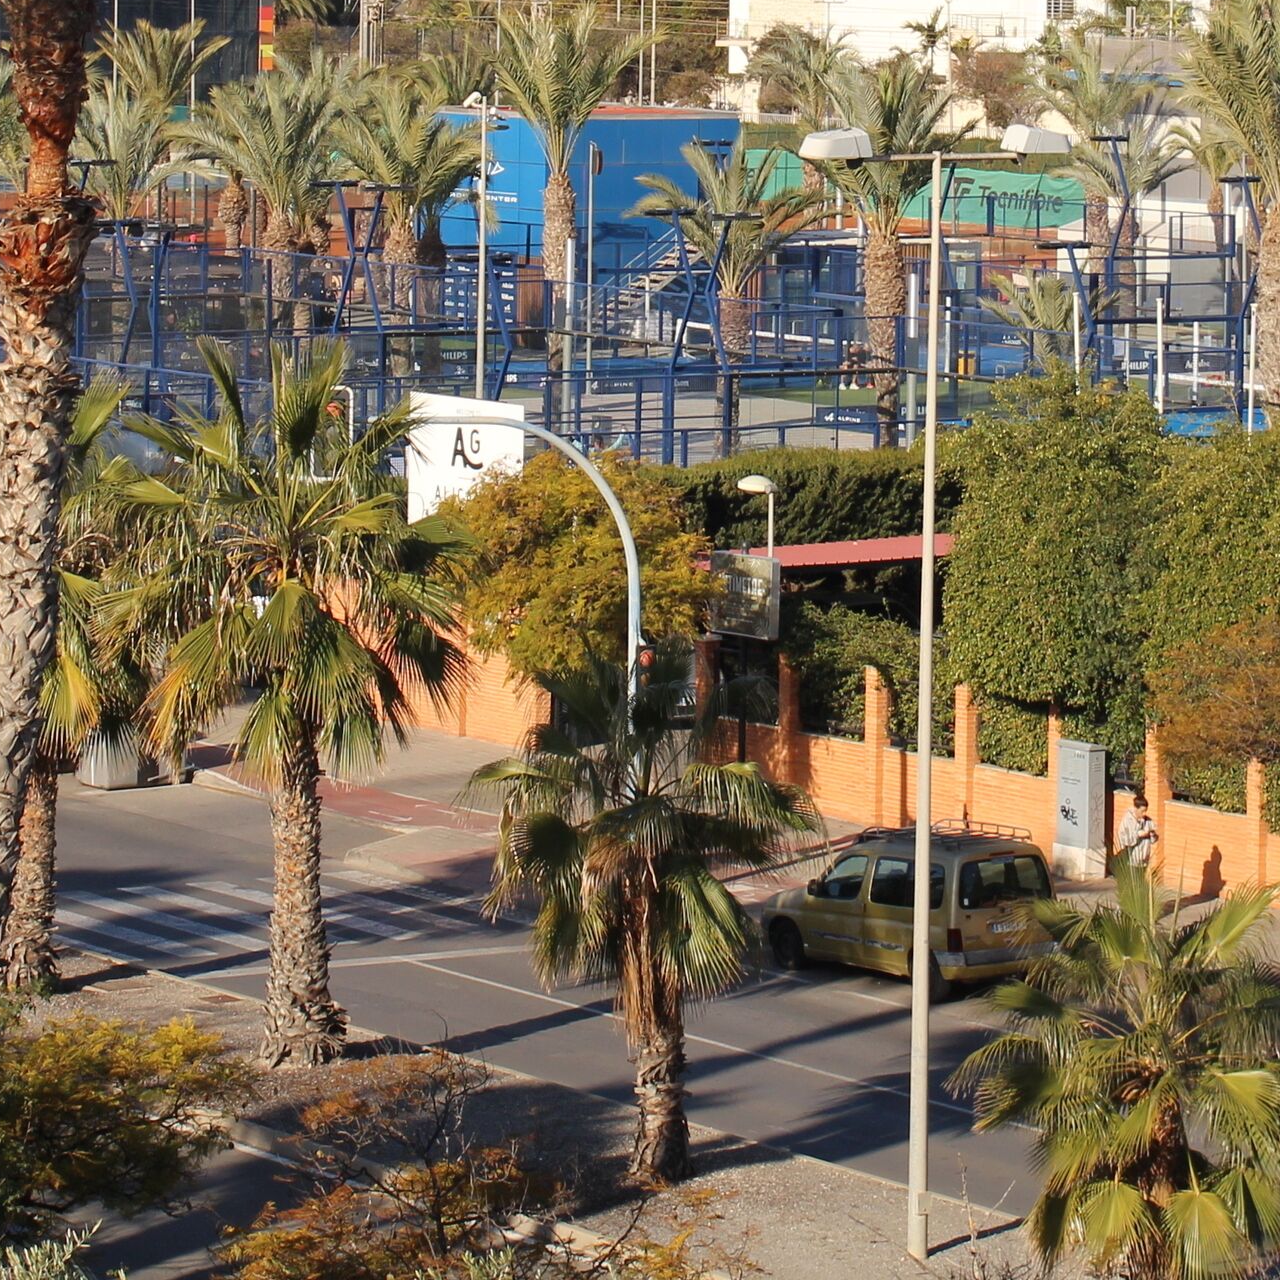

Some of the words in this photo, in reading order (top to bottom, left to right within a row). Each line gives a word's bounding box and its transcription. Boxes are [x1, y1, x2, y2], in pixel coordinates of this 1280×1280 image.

[485, 195, 518, 203] ENTER
[978, 185, 1064, 213] Tecnifibre
[440, 351, 468, 360] HILIPS
[837, 416, 861, 424] ALPINE
